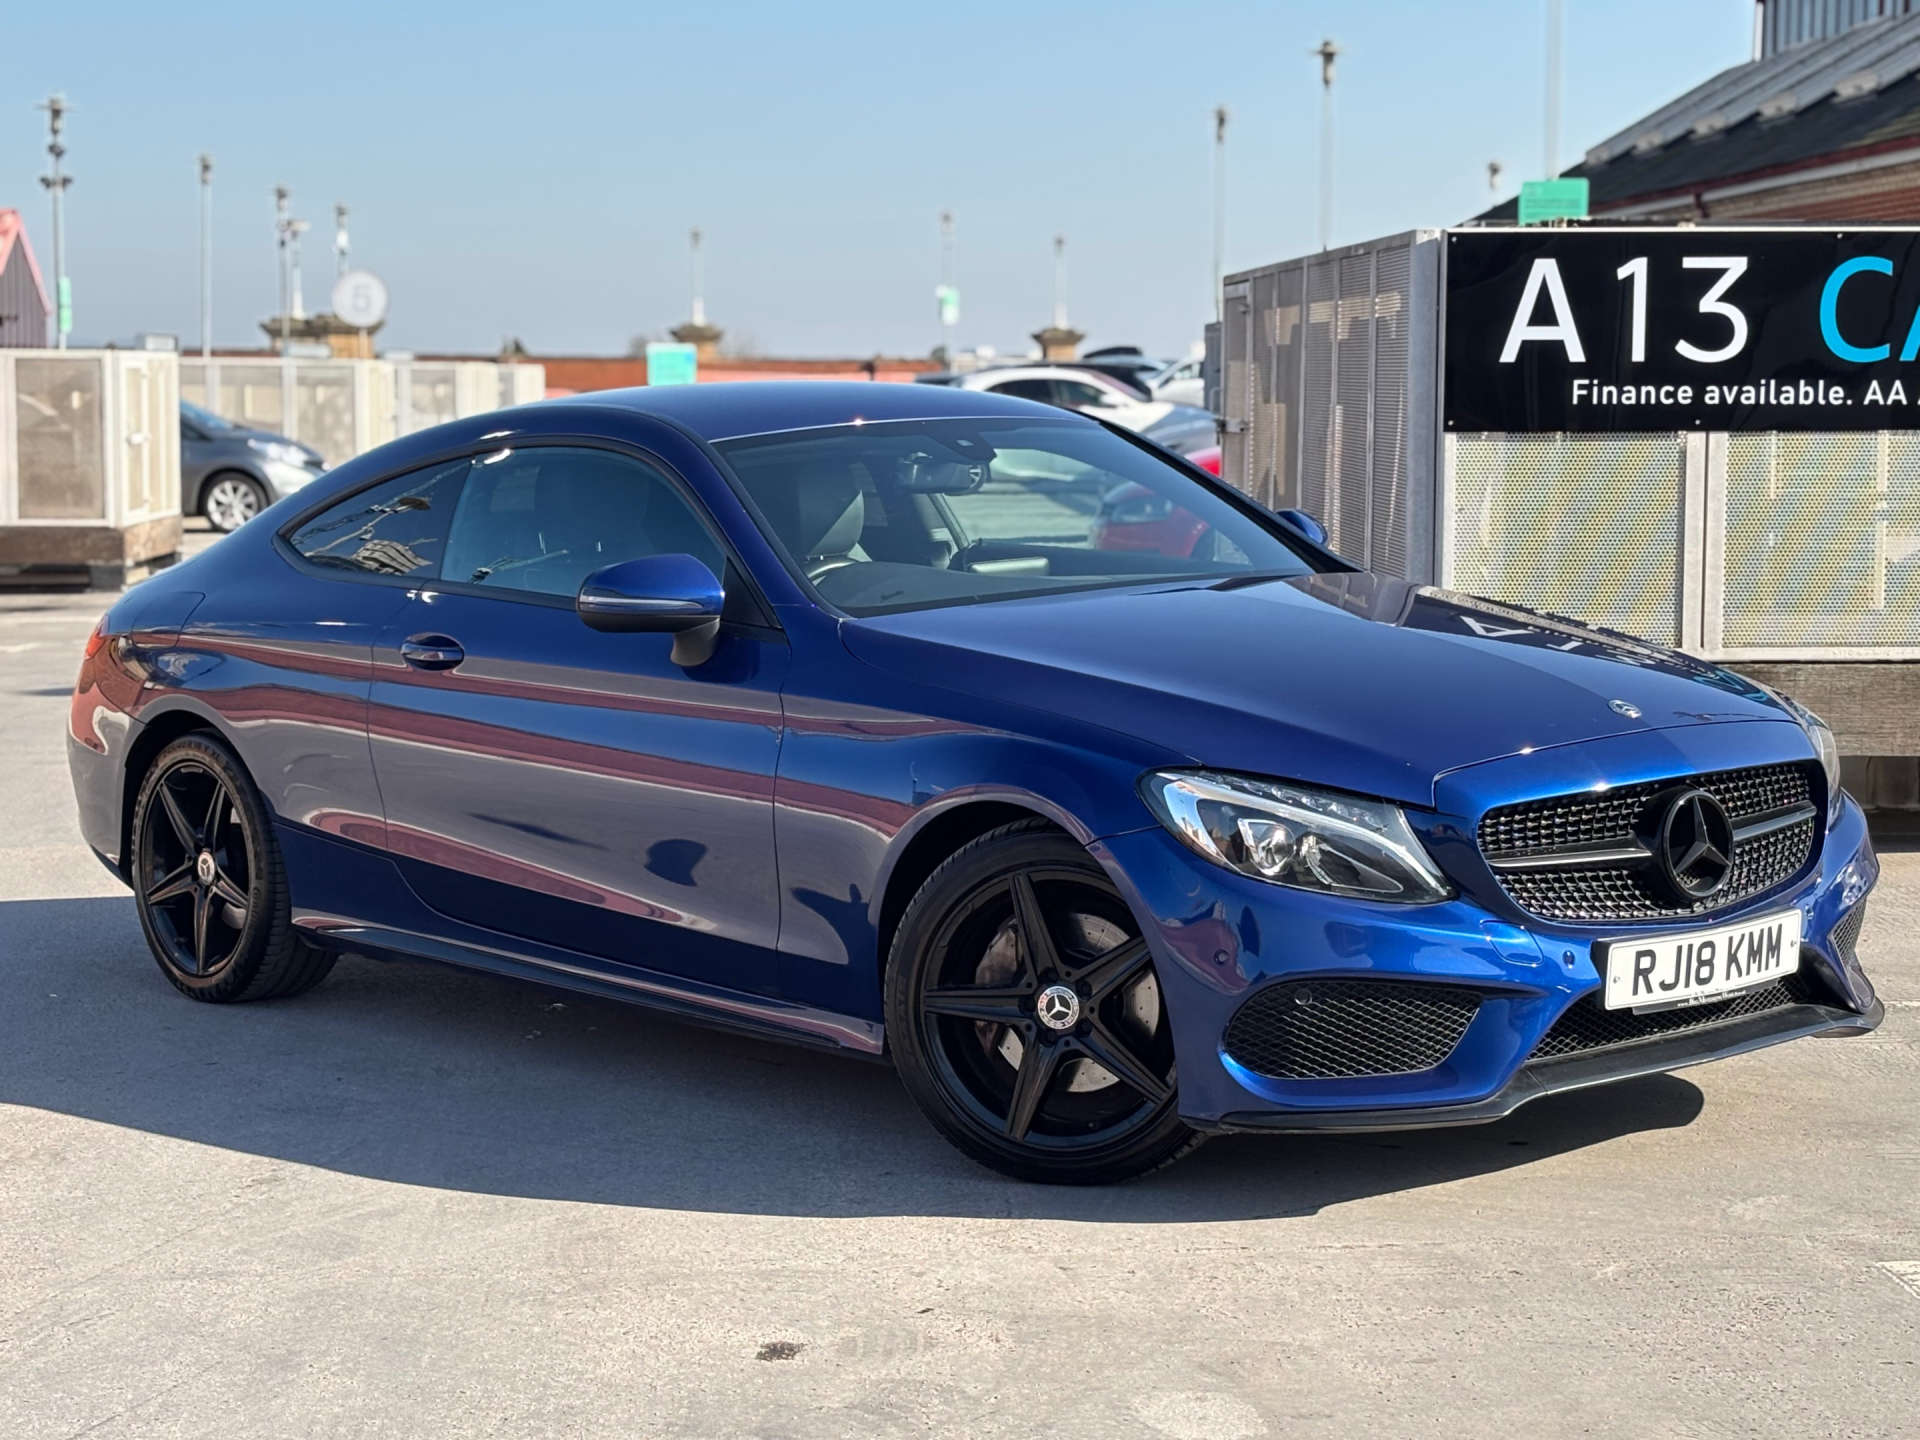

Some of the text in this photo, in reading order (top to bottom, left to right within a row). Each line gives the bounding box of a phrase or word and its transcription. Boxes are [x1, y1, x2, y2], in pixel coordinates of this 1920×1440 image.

[1819, 254, 1920, 363] C
[1572, 378, 1908, 406] Finance available. AA
[1632, 923, 1783, 997] RJ18 KMM
